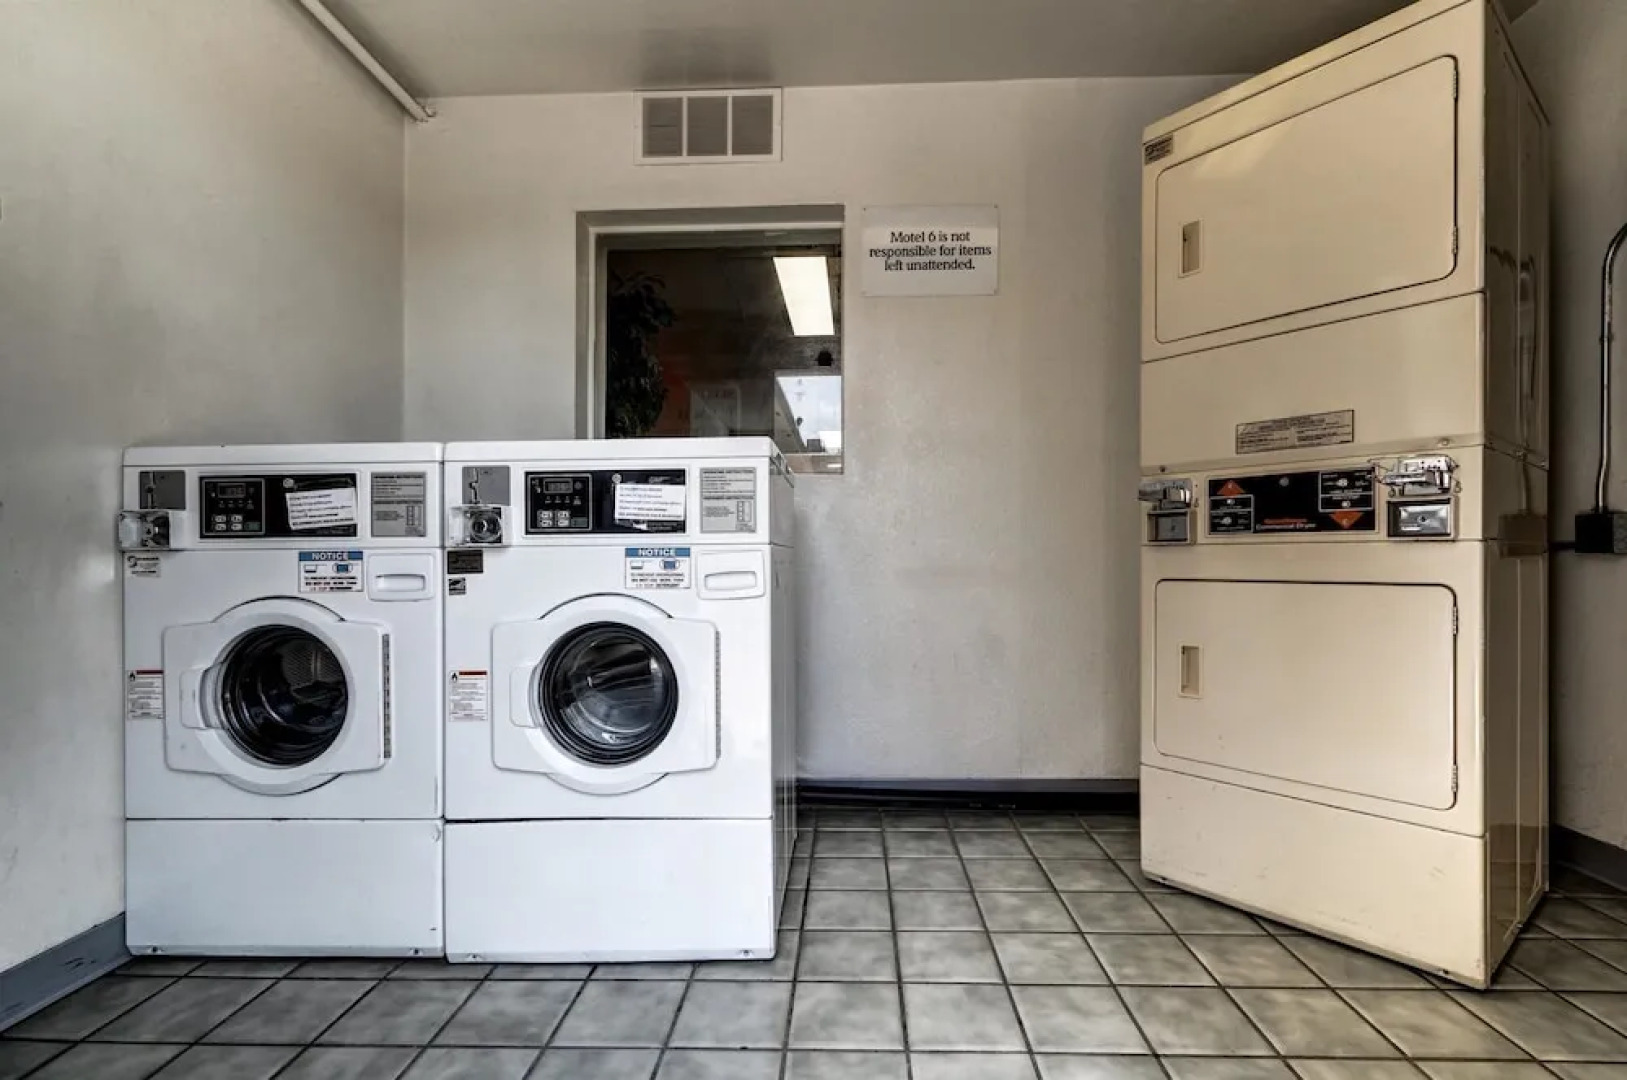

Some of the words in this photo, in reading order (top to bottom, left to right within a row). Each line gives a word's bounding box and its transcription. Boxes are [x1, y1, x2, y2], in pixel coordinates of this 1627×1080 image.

[890, 231, 925, 243] Motel
[928, 231, 936, 242] 6
[938, 231, 948, 242] is
[951, 231, 970, 242] not
[869, 245, 937, 259] responsible
[939, 244, 957, 256] for
[959, 244, 992, 256] items
[884, 259, 903, 271] left
[906, 258, 976, 271] unattended.
[311, 552, 349, 561] NOTICE
[639, 548, 676, 557] NOTICE
